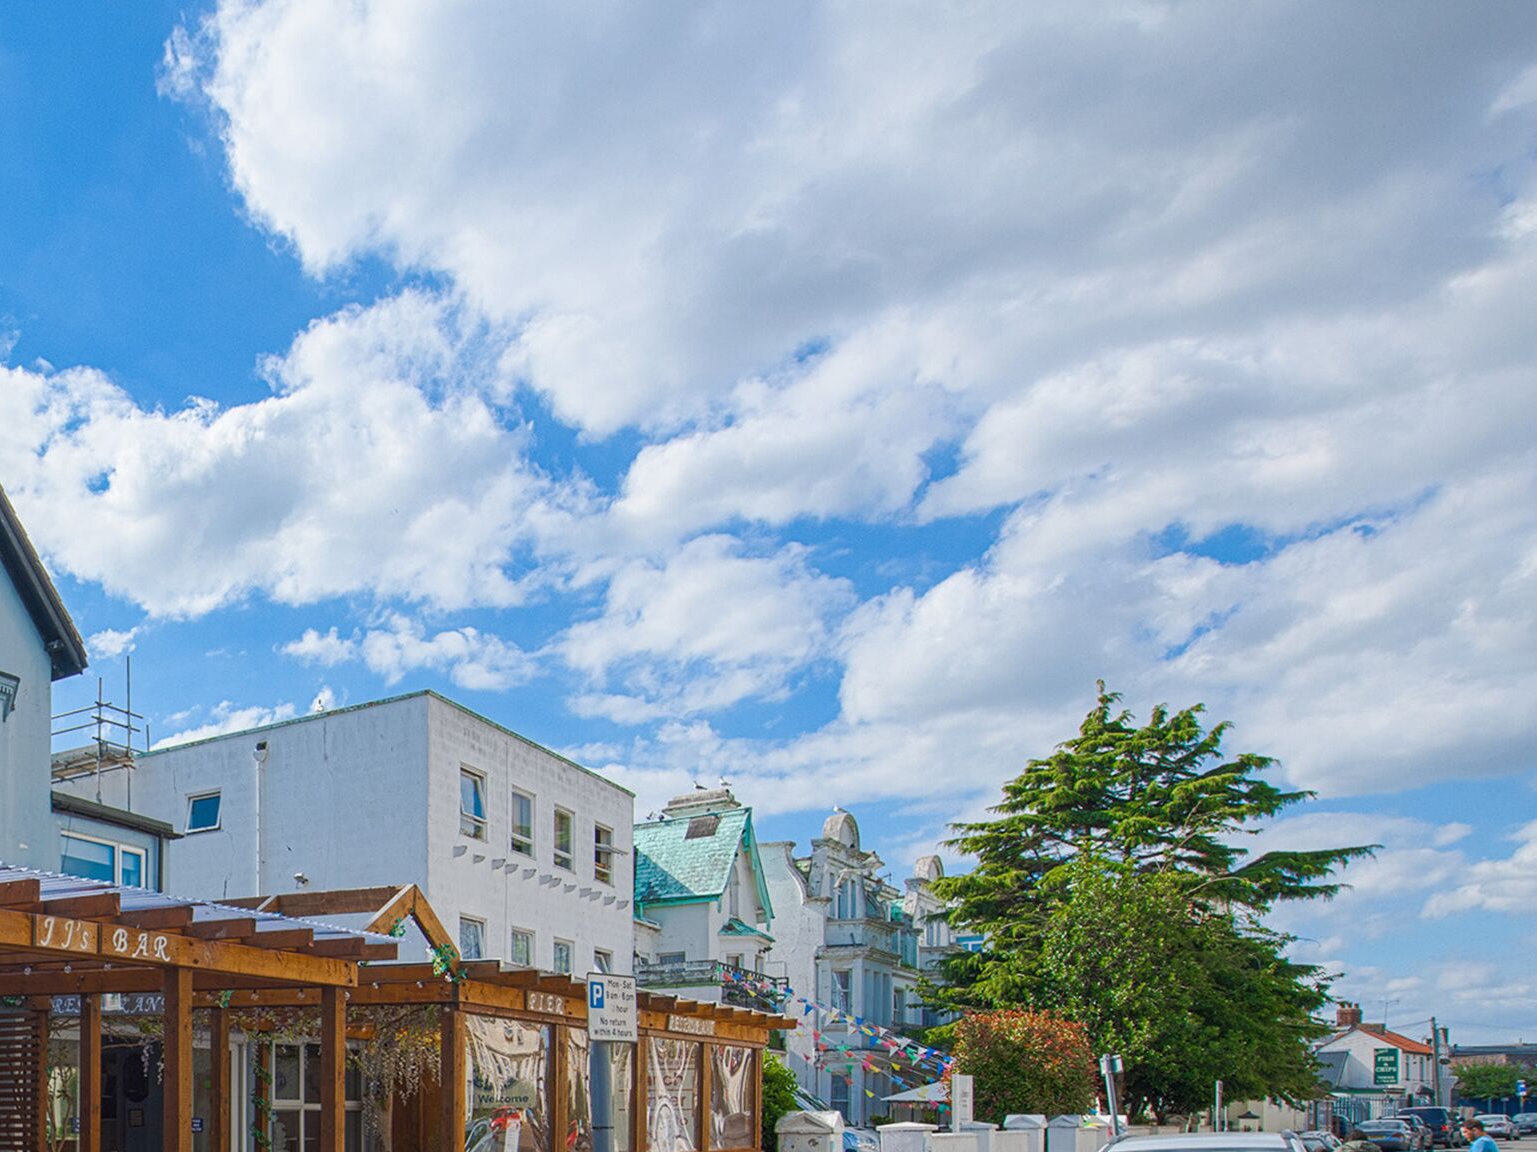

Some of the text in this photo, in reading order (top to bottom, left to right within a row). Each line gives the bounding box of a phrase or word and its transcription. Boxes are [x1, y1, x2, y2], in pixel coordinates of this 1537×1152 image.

[113, 928, 170, 962] BAR
[616, 1005, 628, 1013] hour
[600, 1017, 626, 1026] No return
[617, 1028, 632, 1037] hours
